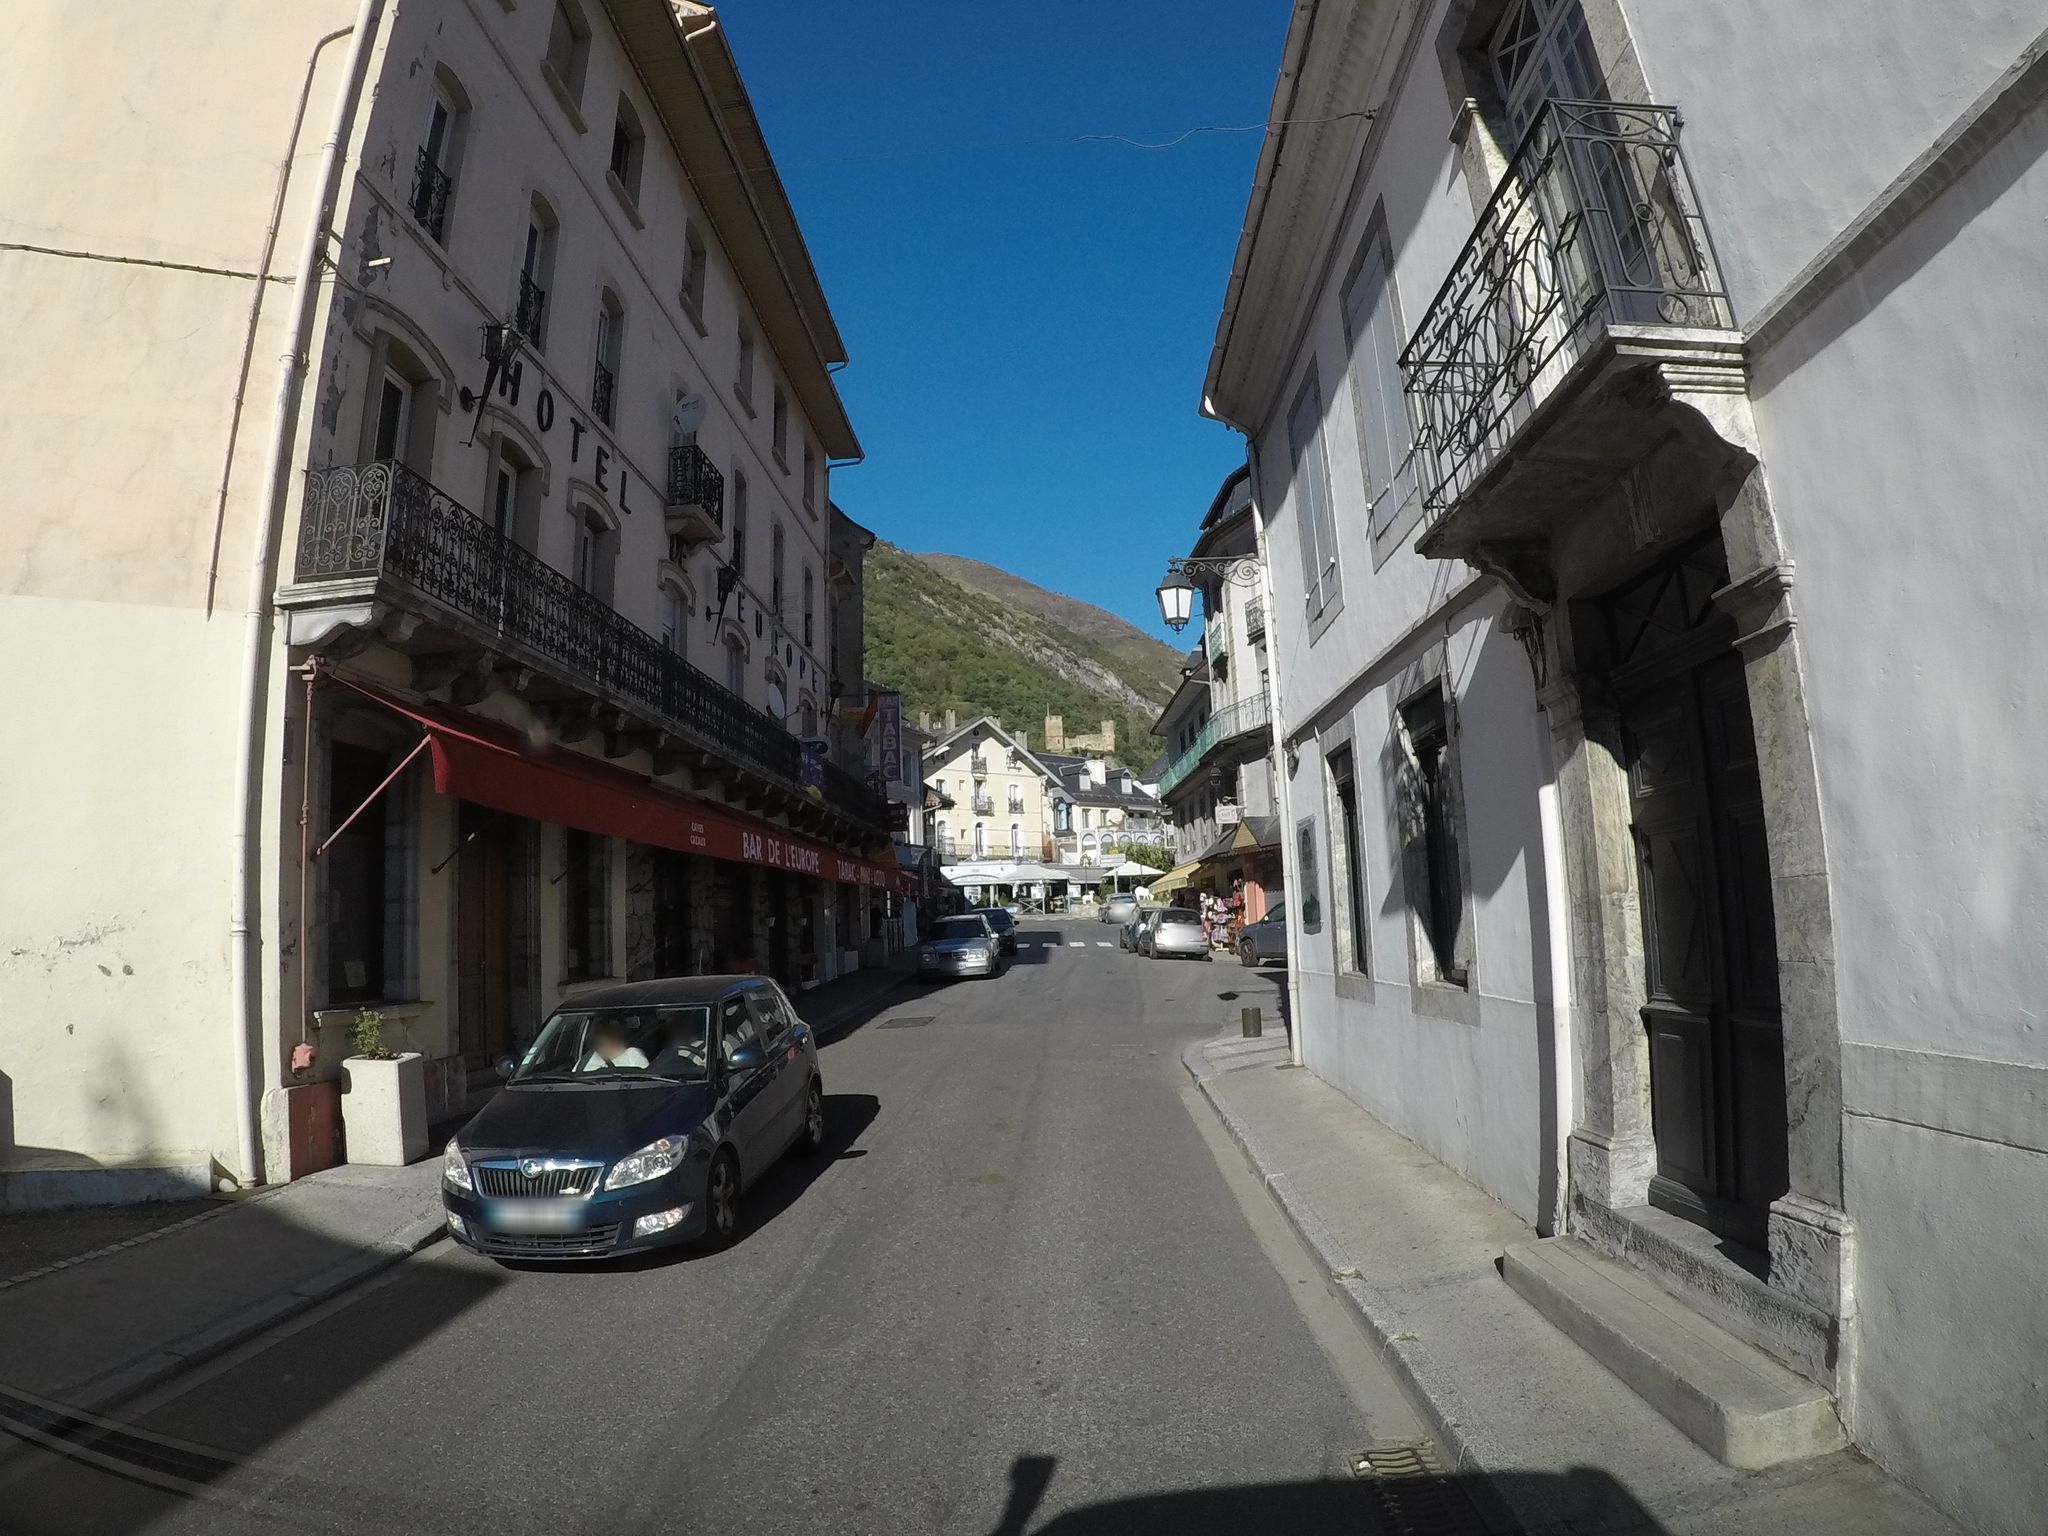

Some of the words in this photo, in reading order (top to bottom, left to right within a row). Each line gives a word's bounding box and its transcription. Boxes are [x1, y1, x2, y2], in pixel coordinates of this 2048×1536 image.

[499, 360, 632, 515] HOTEL
[882, 708, 896, 777] TABAC
[742, 831, 763, 861] BAR
[767, 838, 781, 865] DE
[785, 842, 820, 874] L'EUROPE
[836, 859, 857, 882] TABAC
